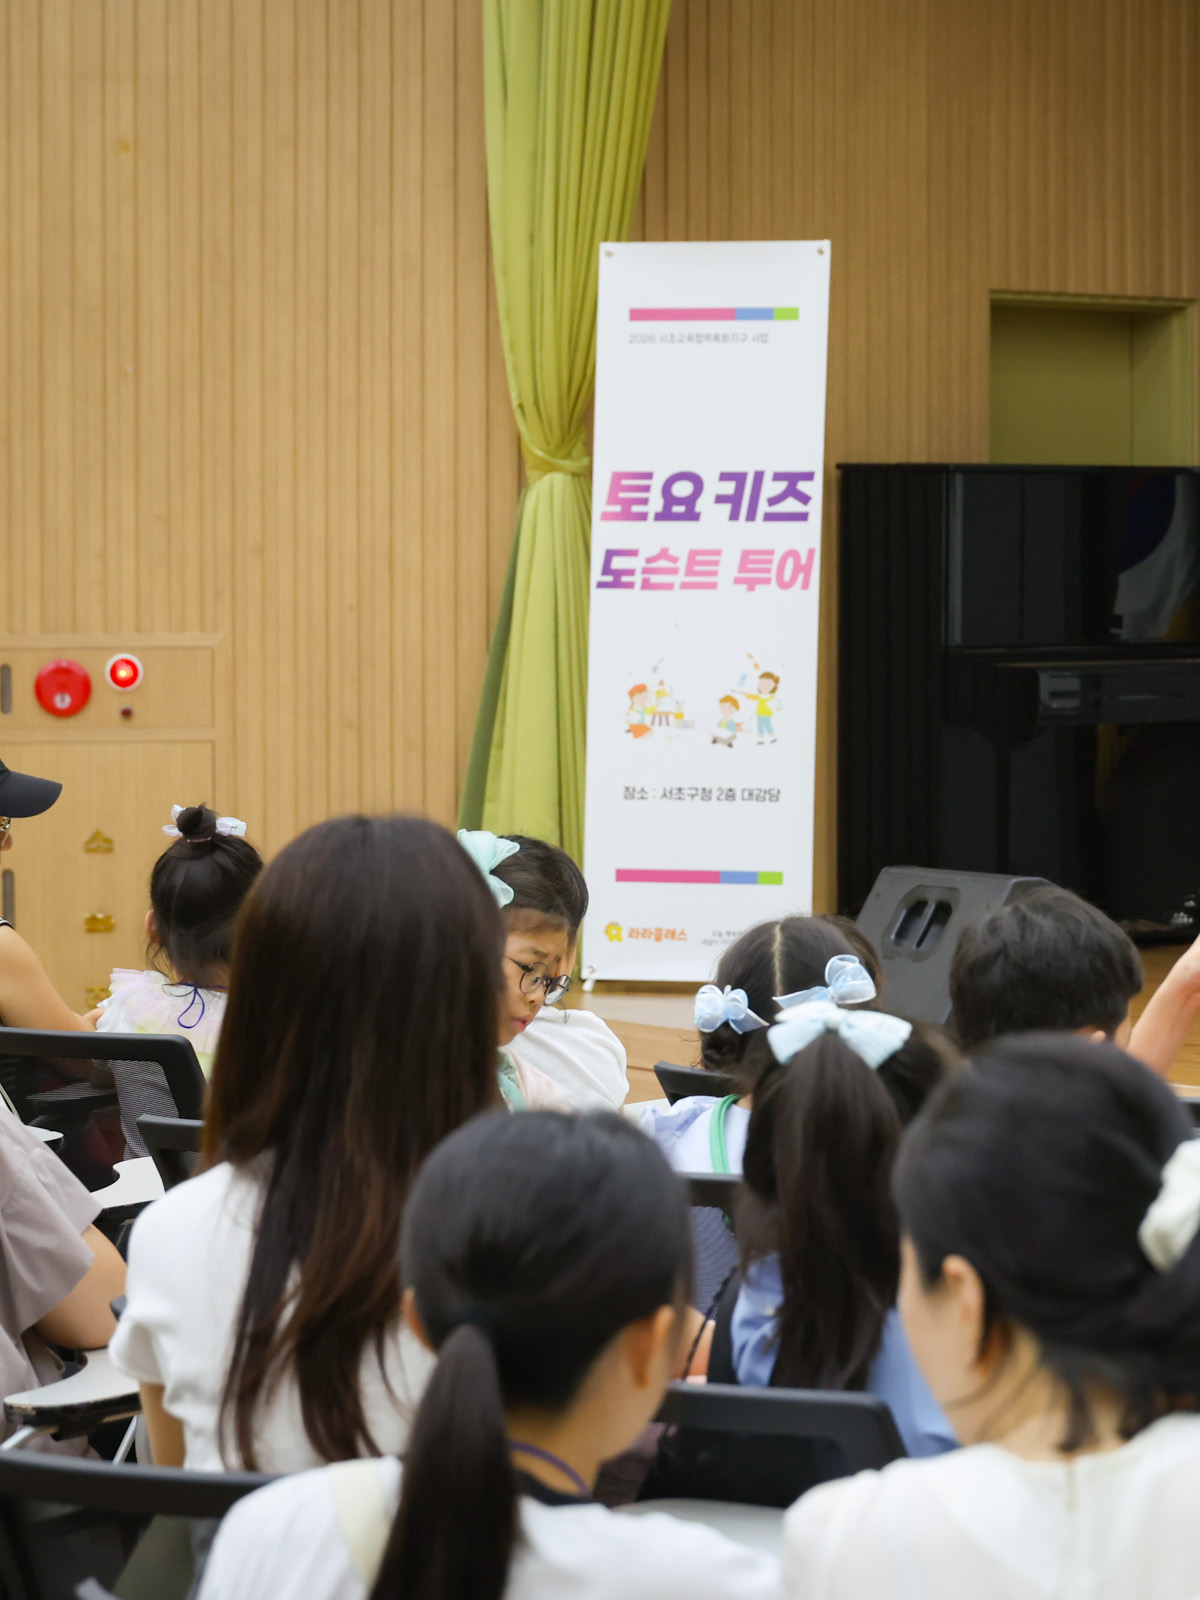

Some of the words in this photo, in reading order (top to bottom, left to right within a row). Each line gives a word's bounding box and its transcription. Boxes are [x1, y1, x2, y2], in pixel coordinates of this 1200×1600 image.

[596, 547, 723, 591] 도슨트
[733, 547, 816, 592] 투어
[623, 785, 649, 801] 장소
[660, 786, 713, 802] 서초구청
[716, 786, 736, 802] 2층
[740, 787, 781, 803] 대강당
